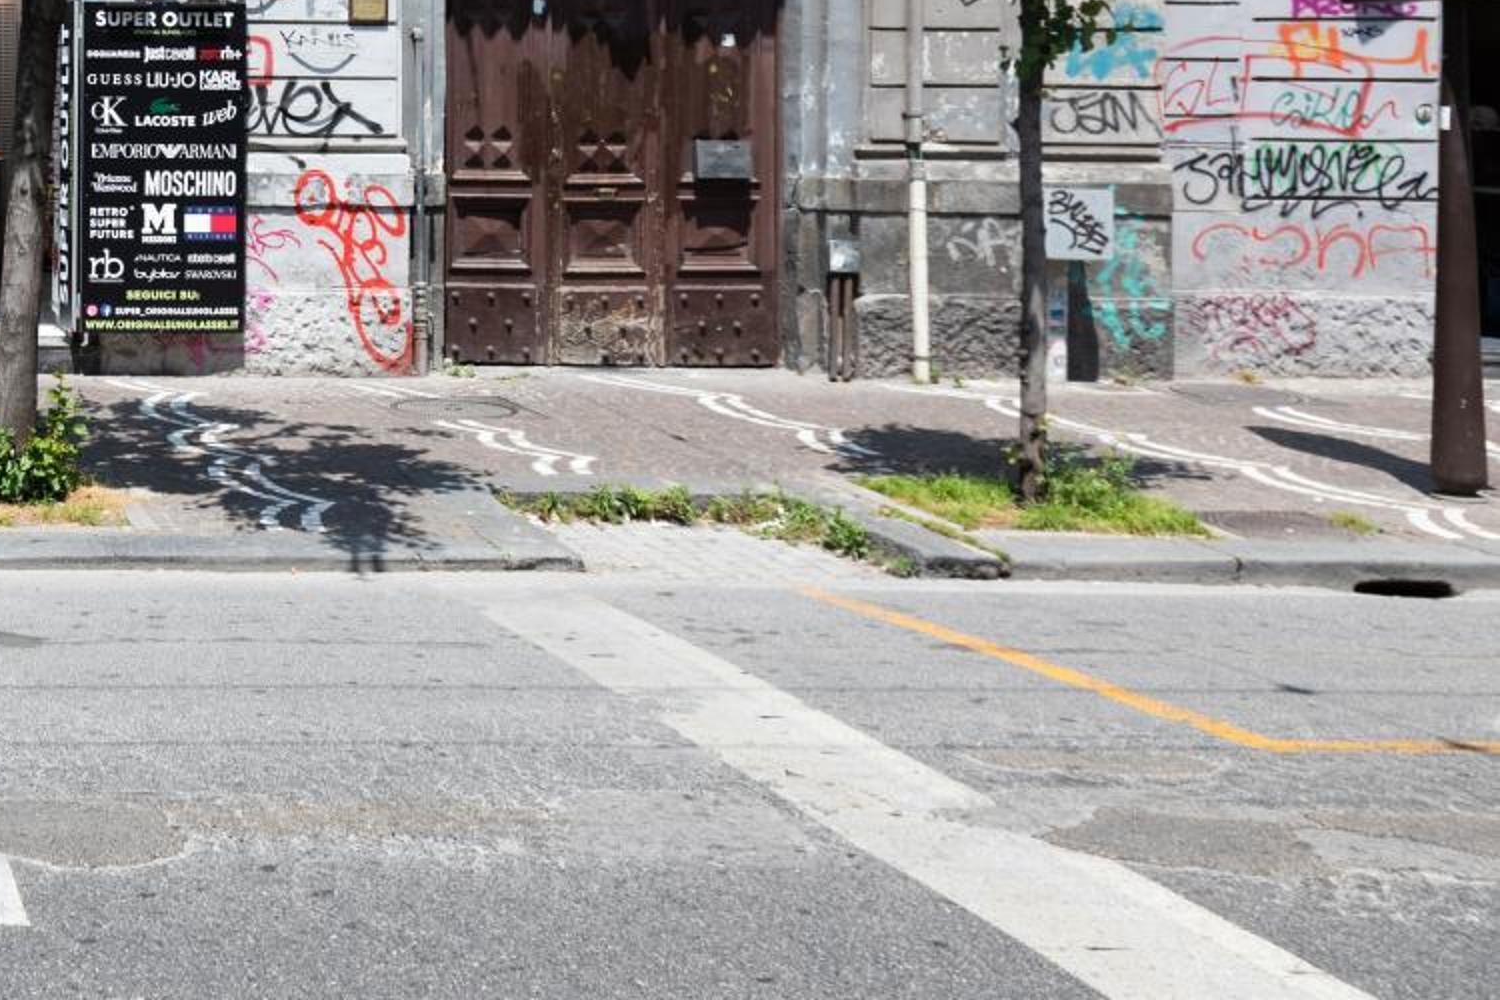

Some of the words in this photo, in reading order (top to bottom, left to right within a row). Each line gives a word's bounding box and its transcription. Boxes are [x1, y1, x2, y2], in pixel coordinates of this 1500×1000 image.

[95, 10, 157, 27] SUPER
[161, 10, 235, 28] OUTLET
[86, 73, 143, 85] GUESS
[199, 70, 241, 83] KARL
[135, 115, 197, 127] LACOSTE
[91, 143, 159, 159] EMPORIO
[179, 143, 237, 159] ARMANI
[145, 170, 237, 197] MOSCHINO
[90, 207, 128, 217] RETRO
[90, 218, 127, 228] SUPER
[141, 203, 178, 235] M
[90, 229, 135, 239] FUTURE
[126, 289, 177, 300] SEGUICI
